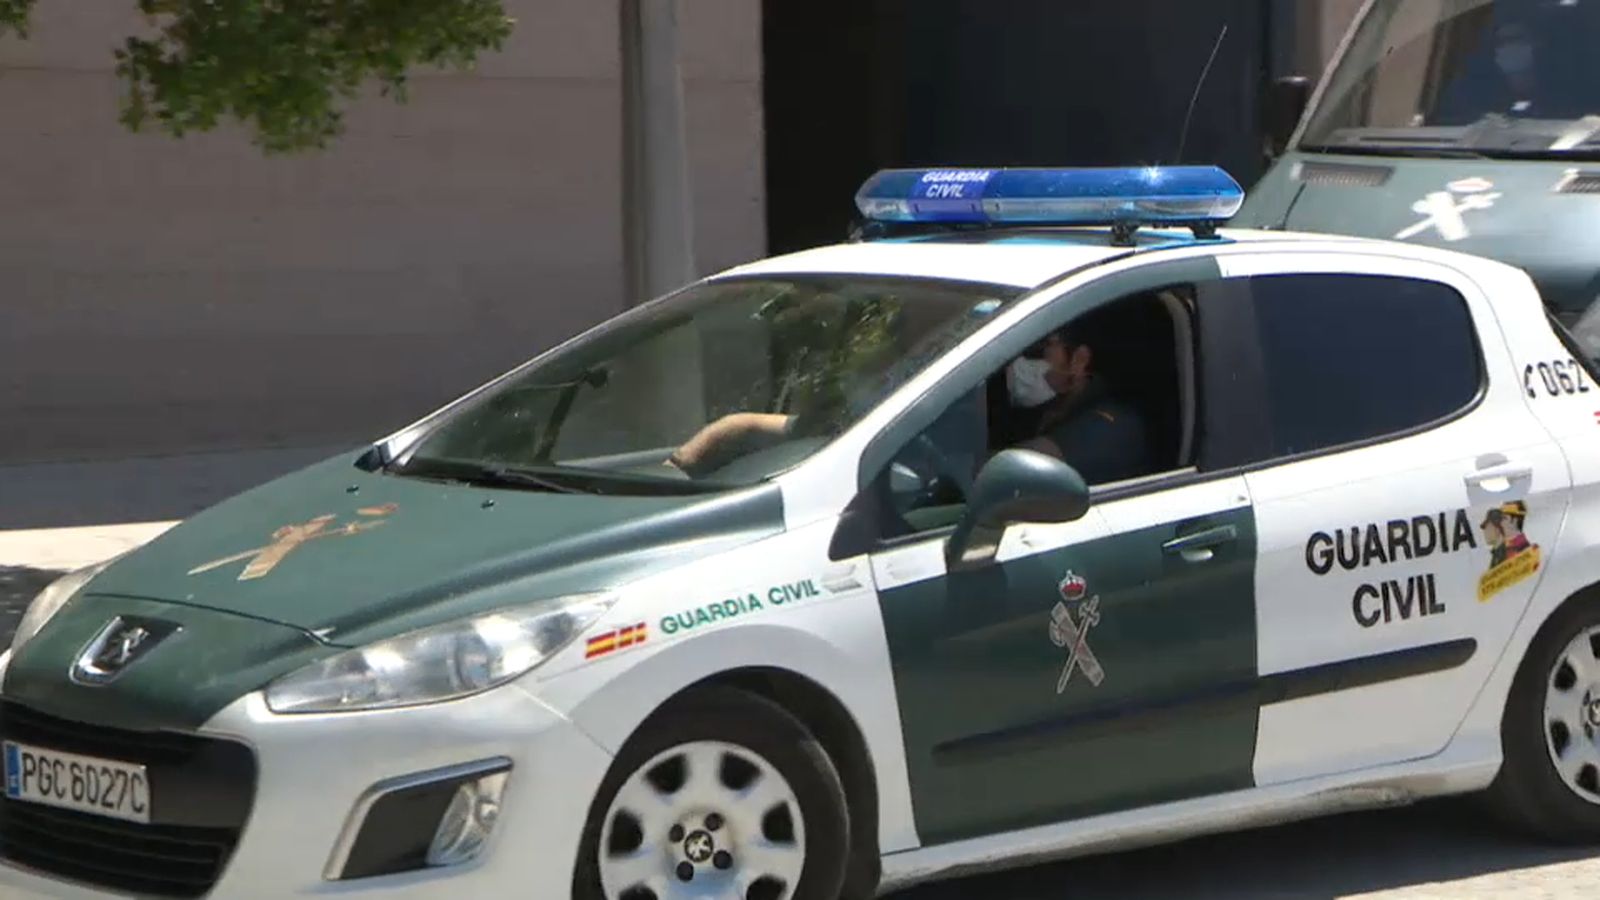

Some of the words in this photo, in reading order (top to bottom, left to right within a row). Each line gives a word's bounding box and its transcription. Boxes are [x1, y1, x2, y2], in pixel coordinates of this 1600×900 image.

[921, 170, 990, 183] GUARDIA
[926, 184, 965, 198] CIVIL
[1537, 359, 1589, 396] 062
[1305, 509, 1477, 575] GUARDIA
[660, 593, 763, 634] GUARDIA
[768, 579, 819, 605] CIVIL
[1352, 574, 1446, 628] CIVIL
